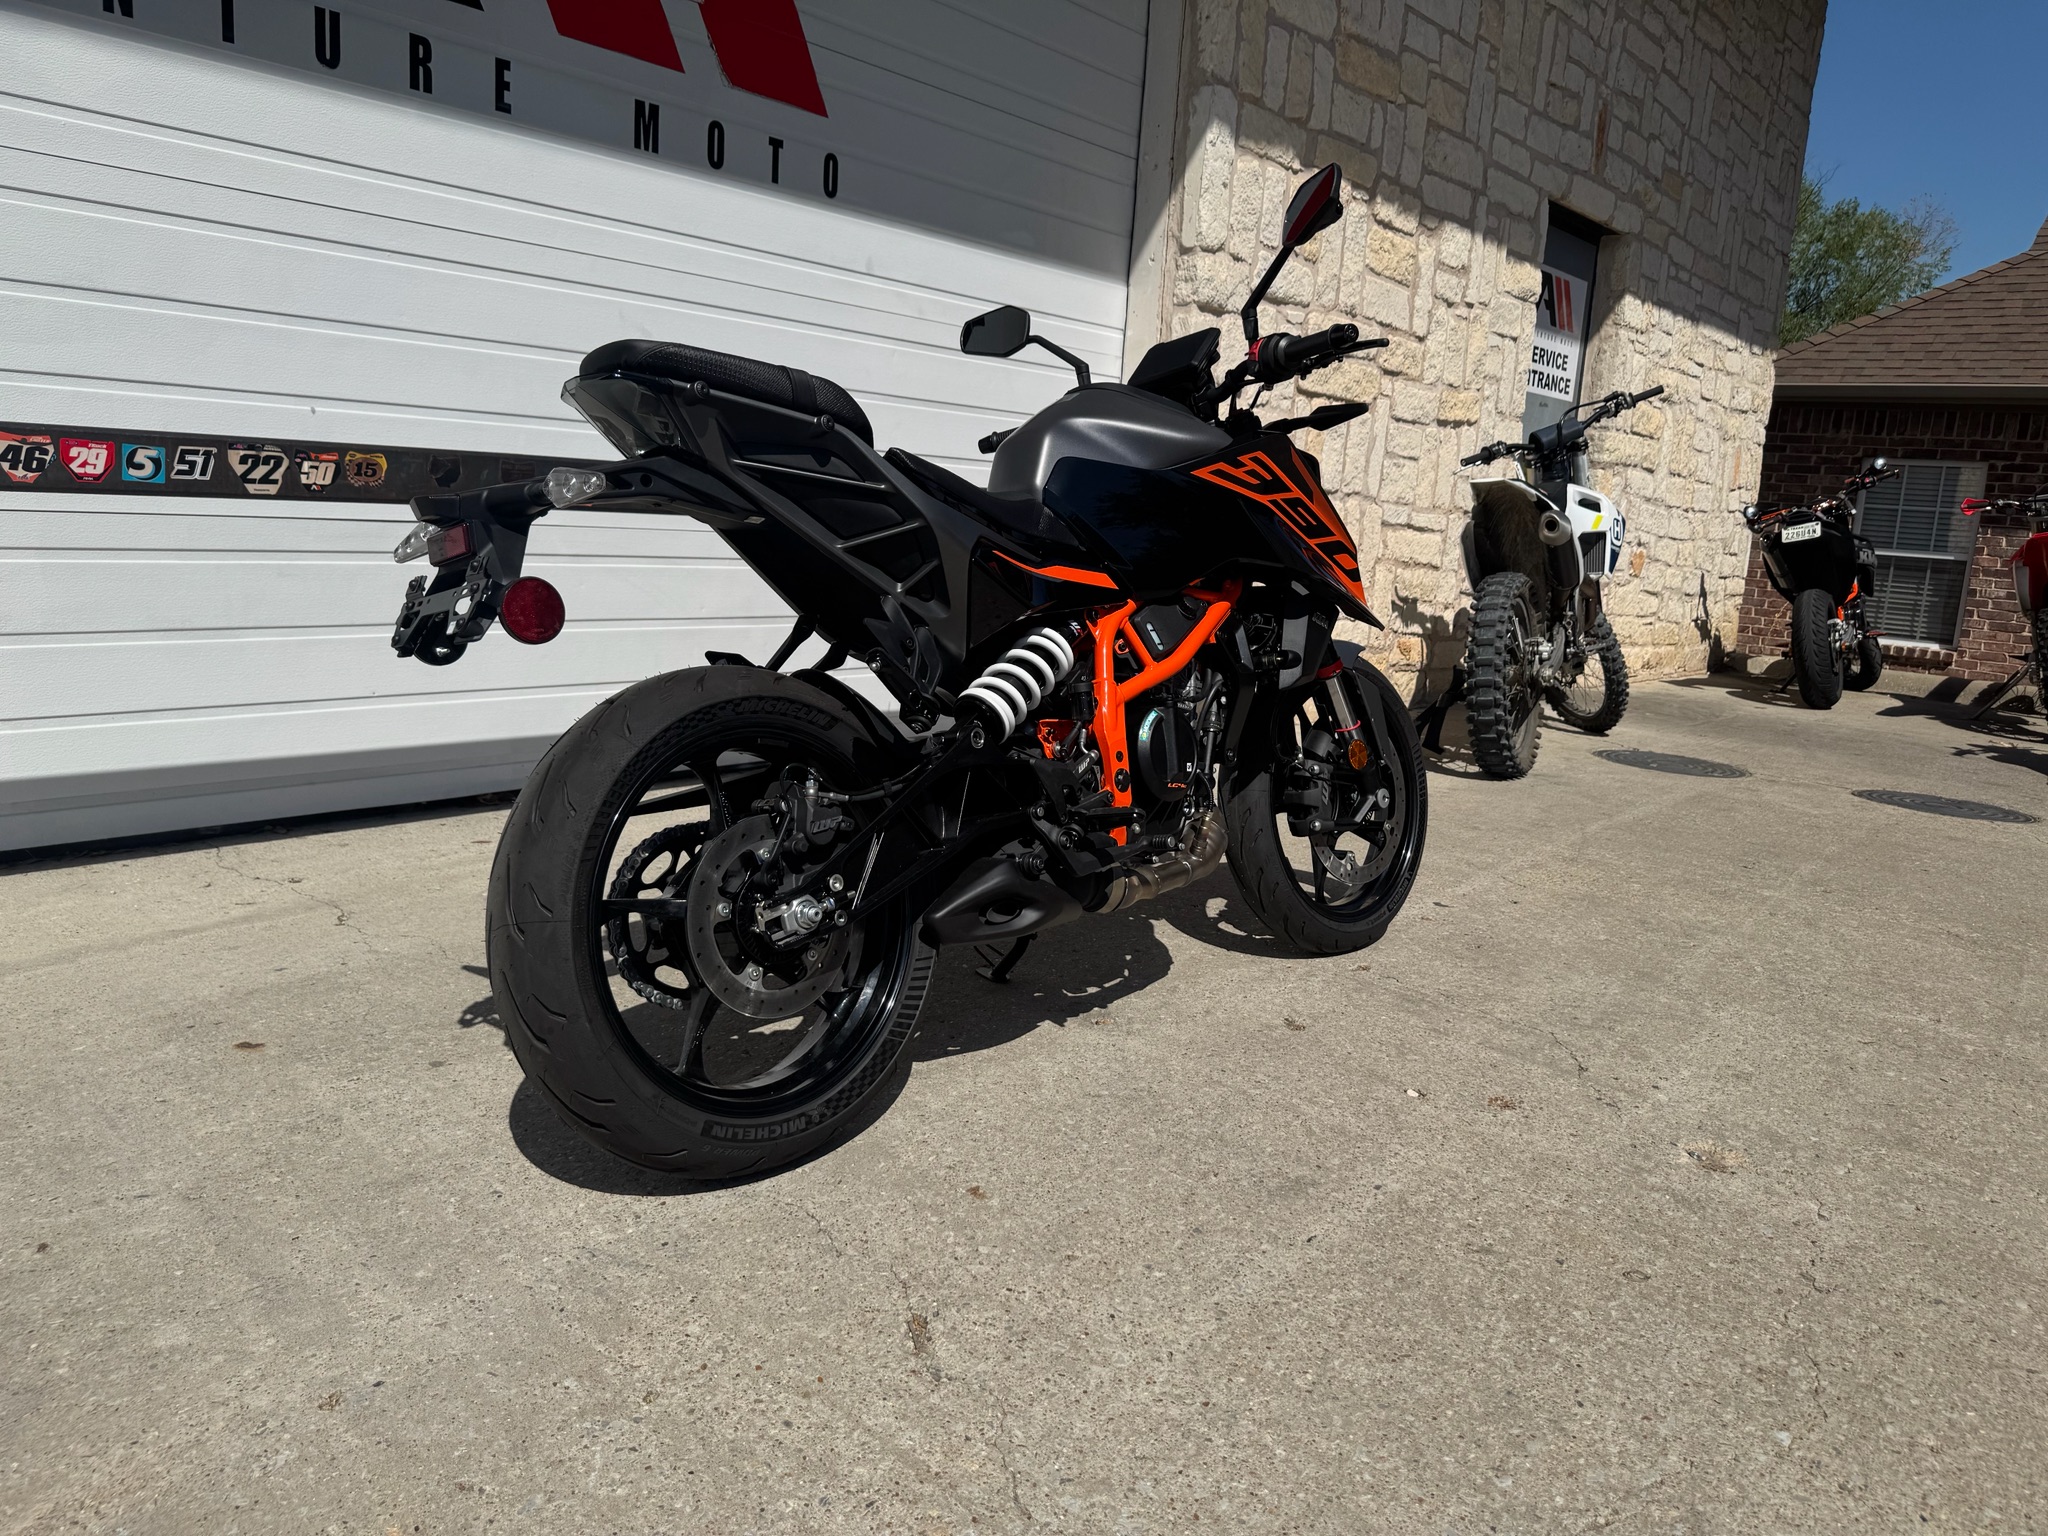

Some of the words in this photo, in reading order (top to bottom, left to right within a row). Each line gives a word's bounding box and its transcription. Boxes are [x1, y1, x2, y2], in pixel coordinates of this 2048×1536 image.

[633, 98, 840, 200] MOTO
[0, 443, 50, 473] 46
[68, 446, 108, 475] 29
[128, 447, 161, 477] 5
[171, 446, 217, 480] 51
[238, 453, 285, 485] 22
[353, 461, 378, 479] 15
[300, 460, 337, 486] 50
[735, 699, 832, 727] MICHELIN
[710, 1114, 807, 1140] MICHELIN
